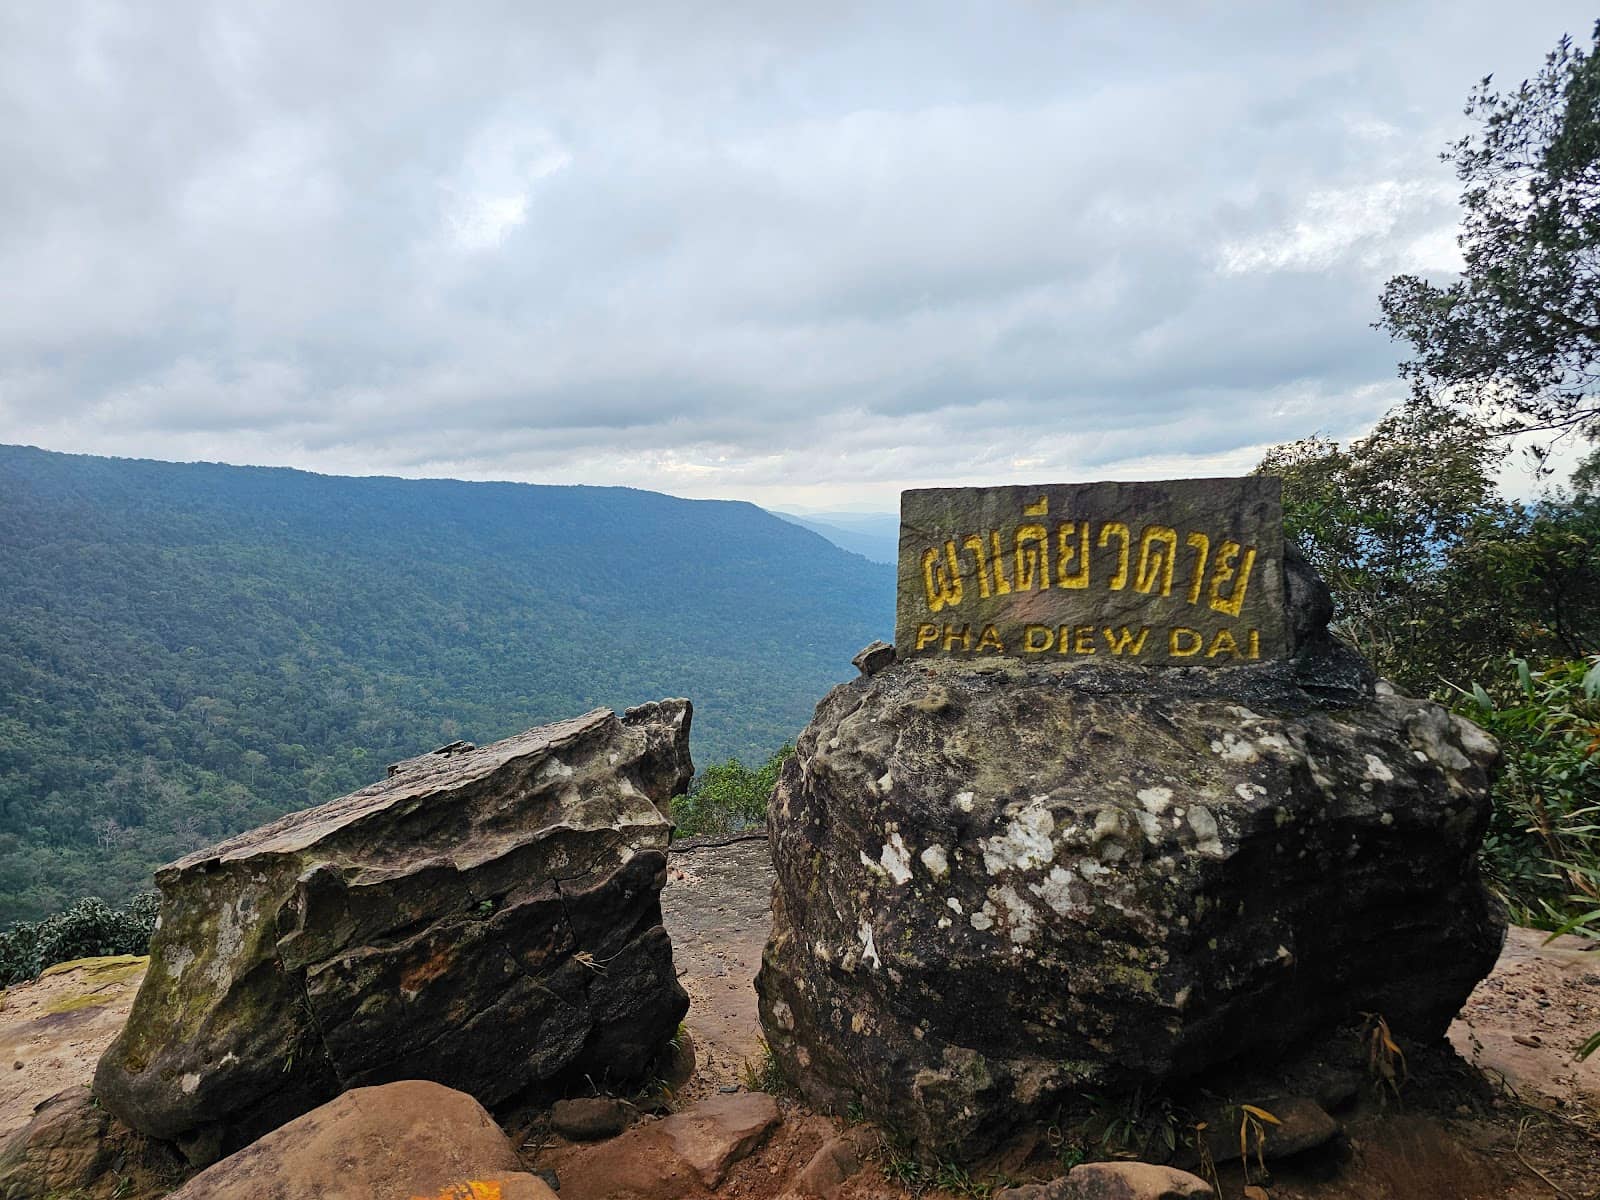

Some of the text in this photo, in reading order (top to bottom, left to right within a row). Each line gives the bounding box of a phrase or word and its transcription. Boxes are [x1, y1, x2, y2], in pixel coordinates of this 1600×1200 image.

[921, 496, 1256, 617] ผาเดียวดาย
[915, 624, 1260, 659] PHA DIEW DAI
